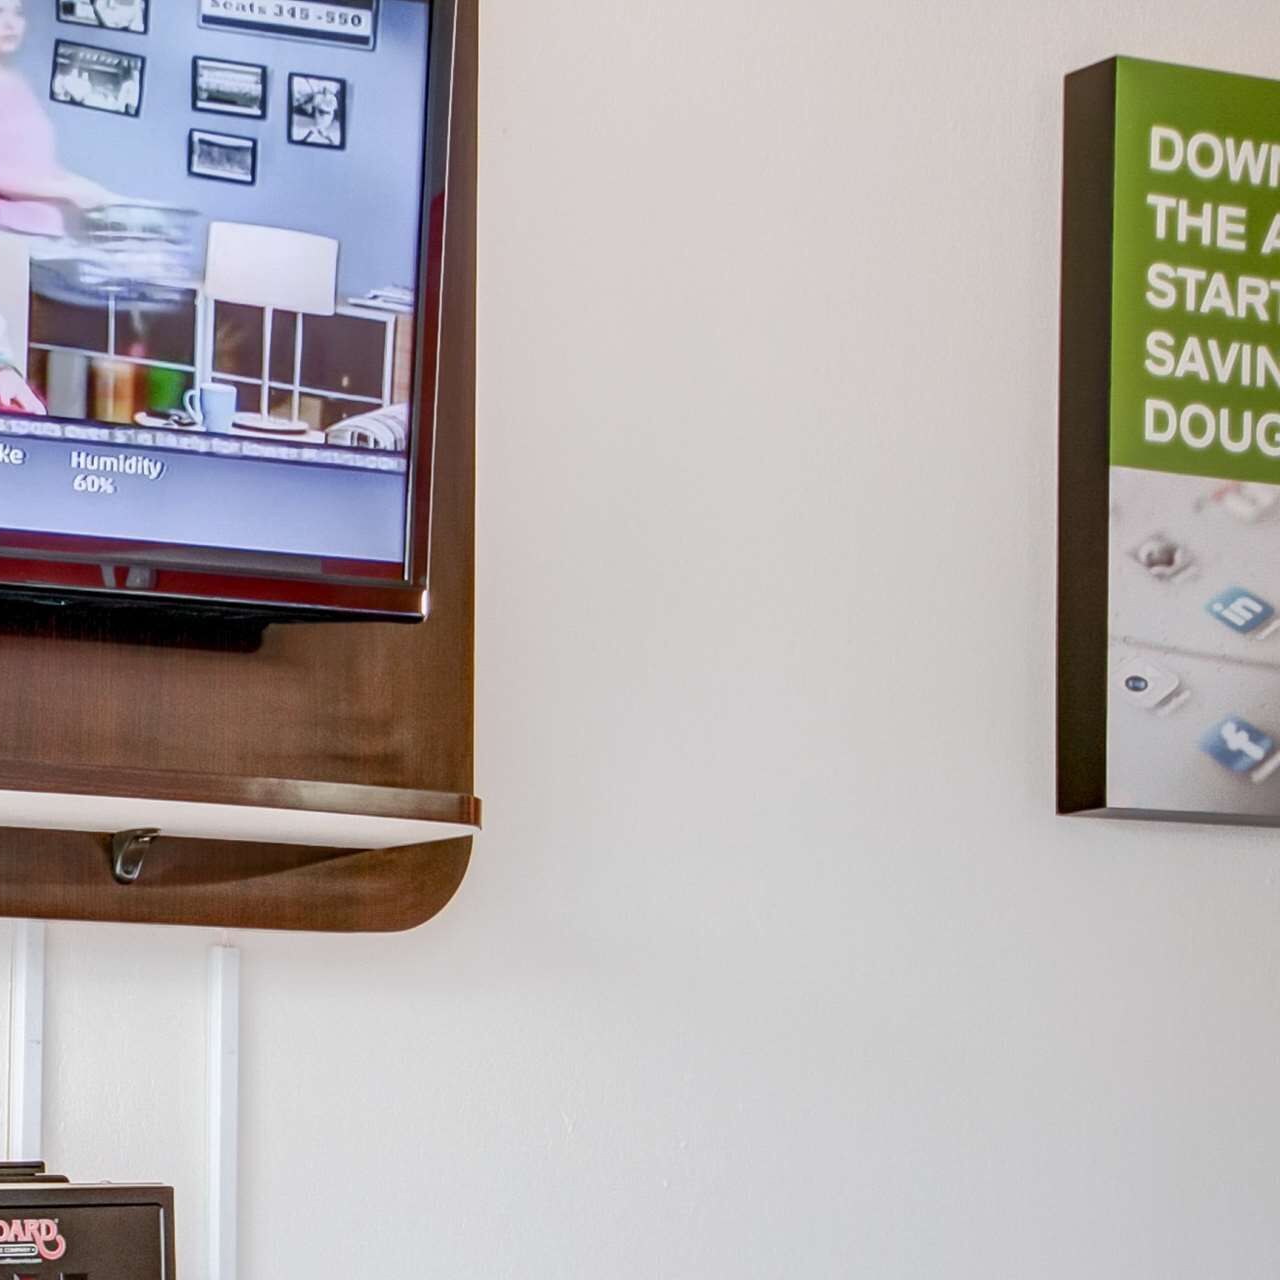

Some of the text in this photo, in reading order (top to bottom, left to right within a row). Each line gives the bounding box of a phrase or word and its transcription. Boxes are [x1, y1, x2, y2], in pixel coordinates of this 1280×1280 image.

[1146, 193, 1248, 251] THE
[1144, 330, 1280, 388] SAVIN
[1144, 398, 1280, 457] DOUG
[70, 451, 163, 479] Humidity
[72, 475, 115, 494] 60%
